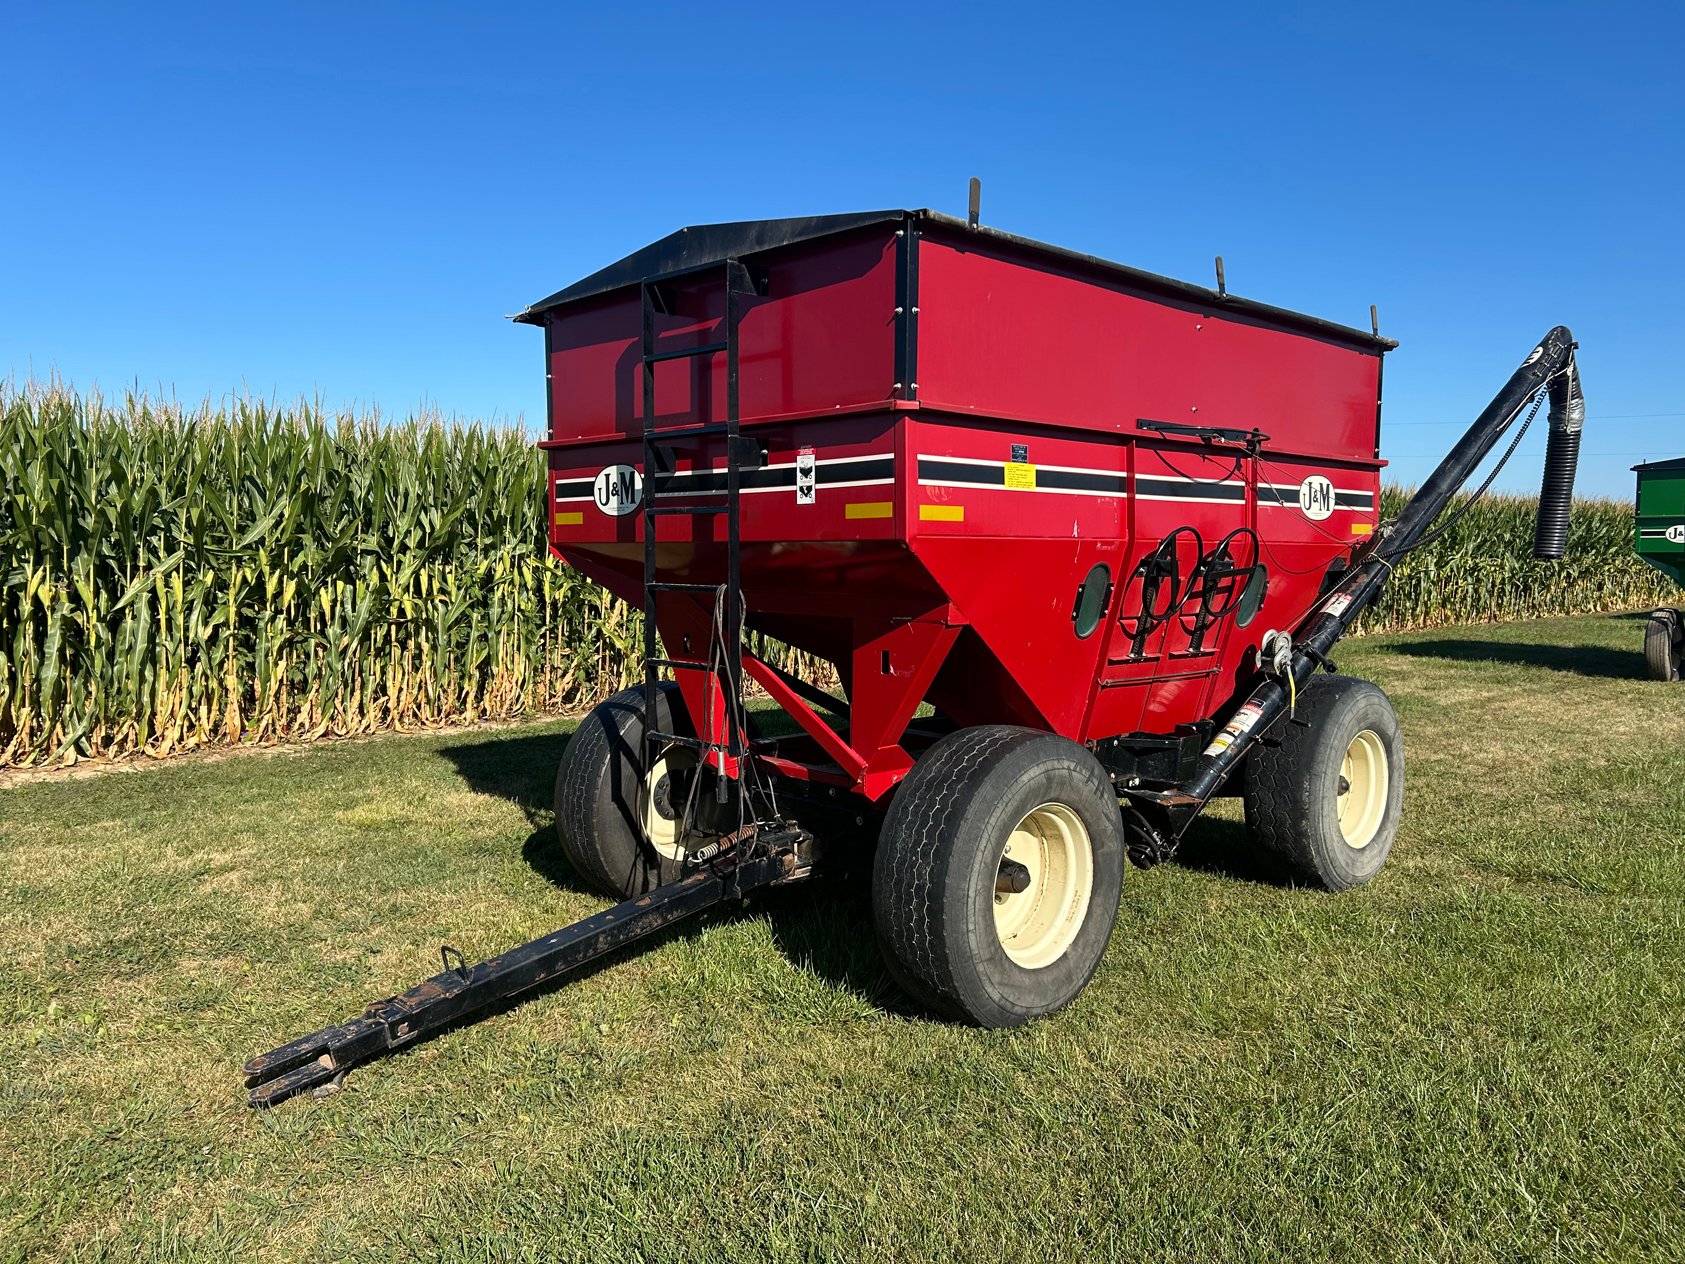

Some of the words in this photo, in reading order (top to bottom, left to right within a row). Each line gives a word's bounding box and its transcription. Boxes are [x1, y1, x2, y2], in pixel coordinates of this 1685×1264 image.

[598, 471, 637, 506] J&M
[1303, 482, 1330, 511] J&M
[1669, 528, 1685, 540] J&
